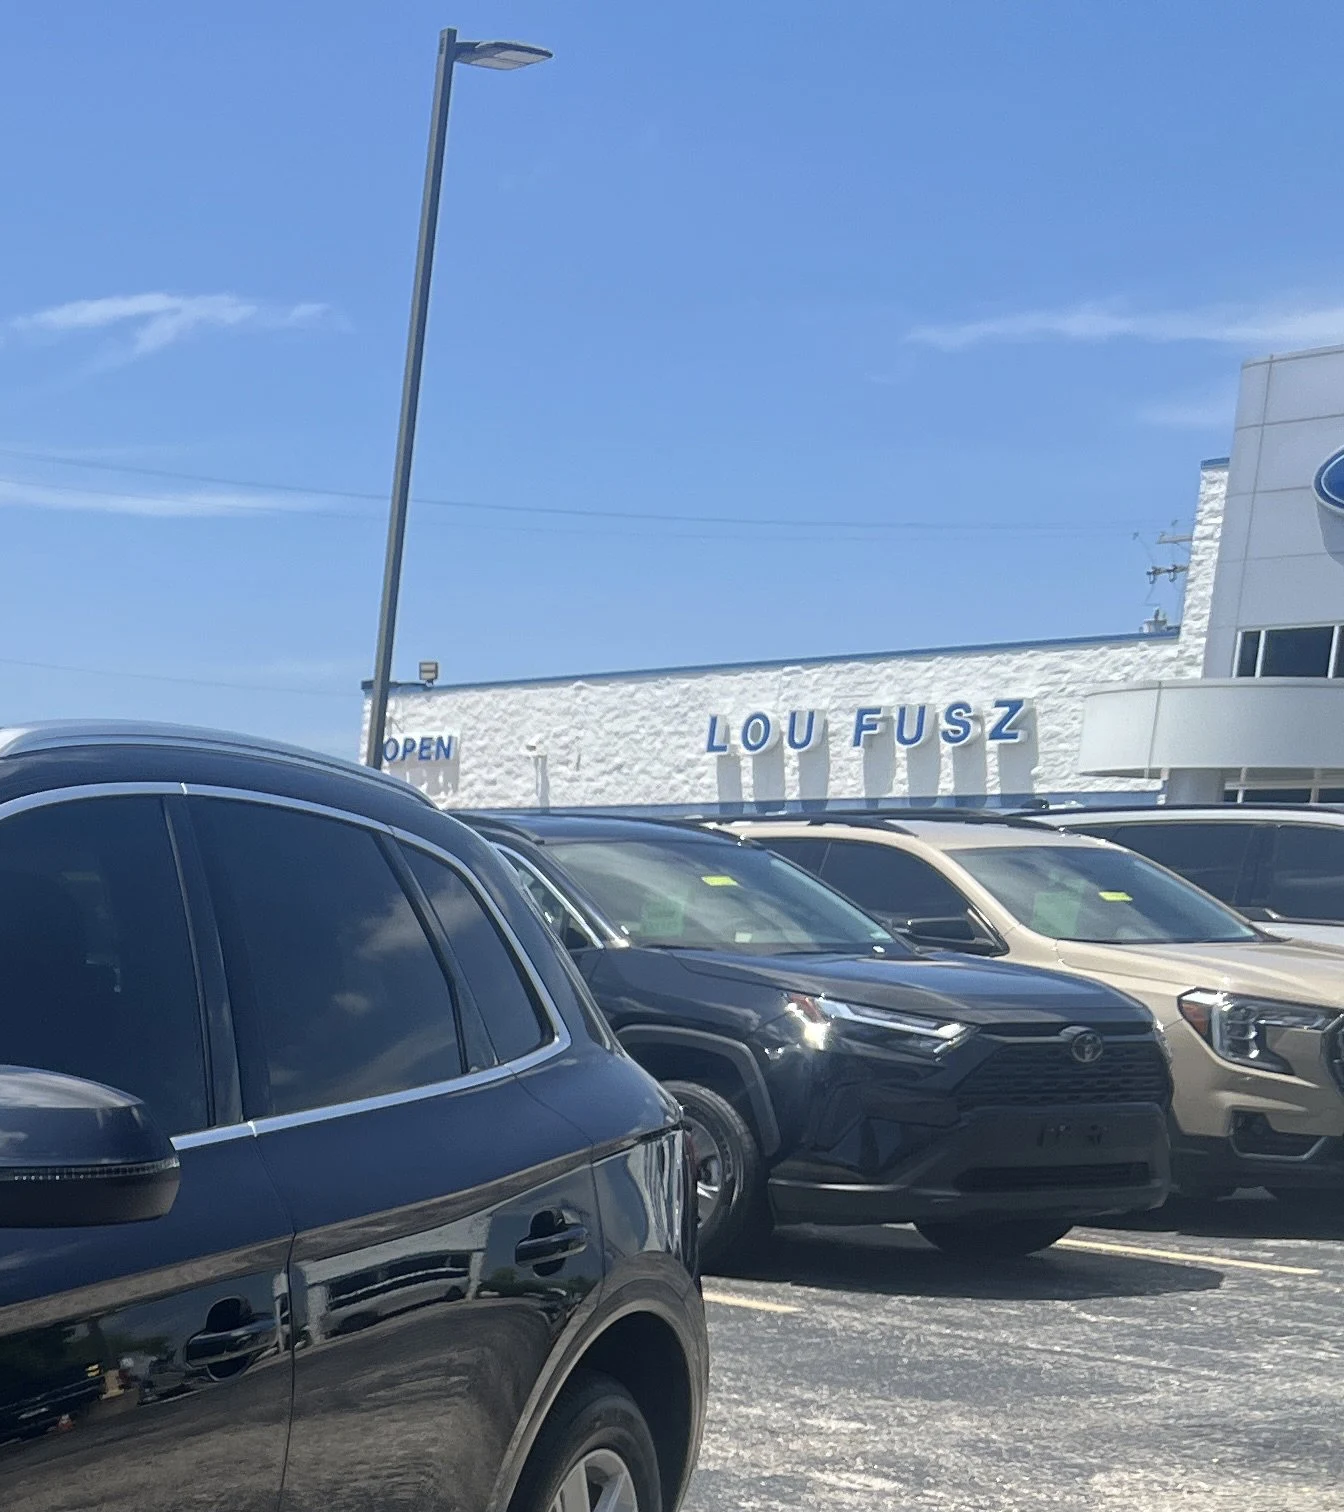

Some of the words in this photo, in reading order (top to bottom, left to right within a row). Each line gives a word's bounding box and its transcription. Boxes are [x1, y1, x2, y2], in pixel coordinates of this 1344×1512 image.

[706, 708, 816, 753] LOU
[851, 698, 1026, 749] FUSZ
[383, 735, 453, 762] OPEN
